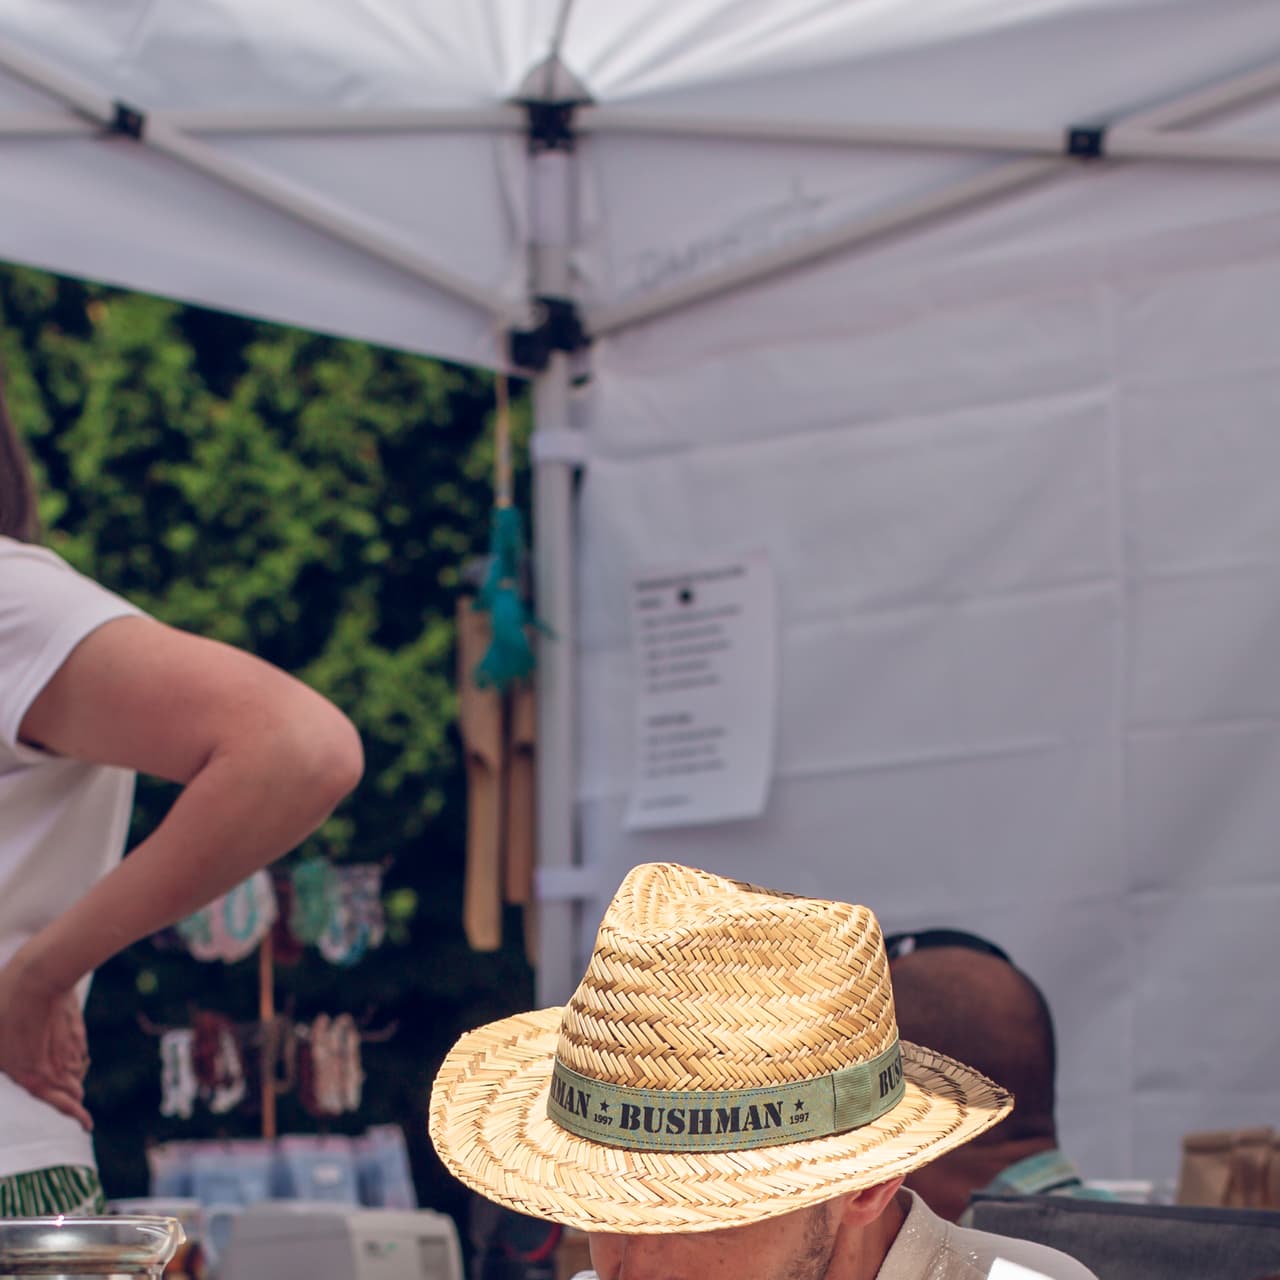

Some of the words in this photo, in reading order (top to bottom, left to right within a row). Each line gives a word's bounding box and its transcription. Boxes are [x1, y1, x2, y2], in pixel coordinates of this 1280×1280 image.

[593, 1112, 613, 1126] 1997
[619, 1101, 784, 1135] BUSHMAN
[789, 1112, 810, 1125] 1997
